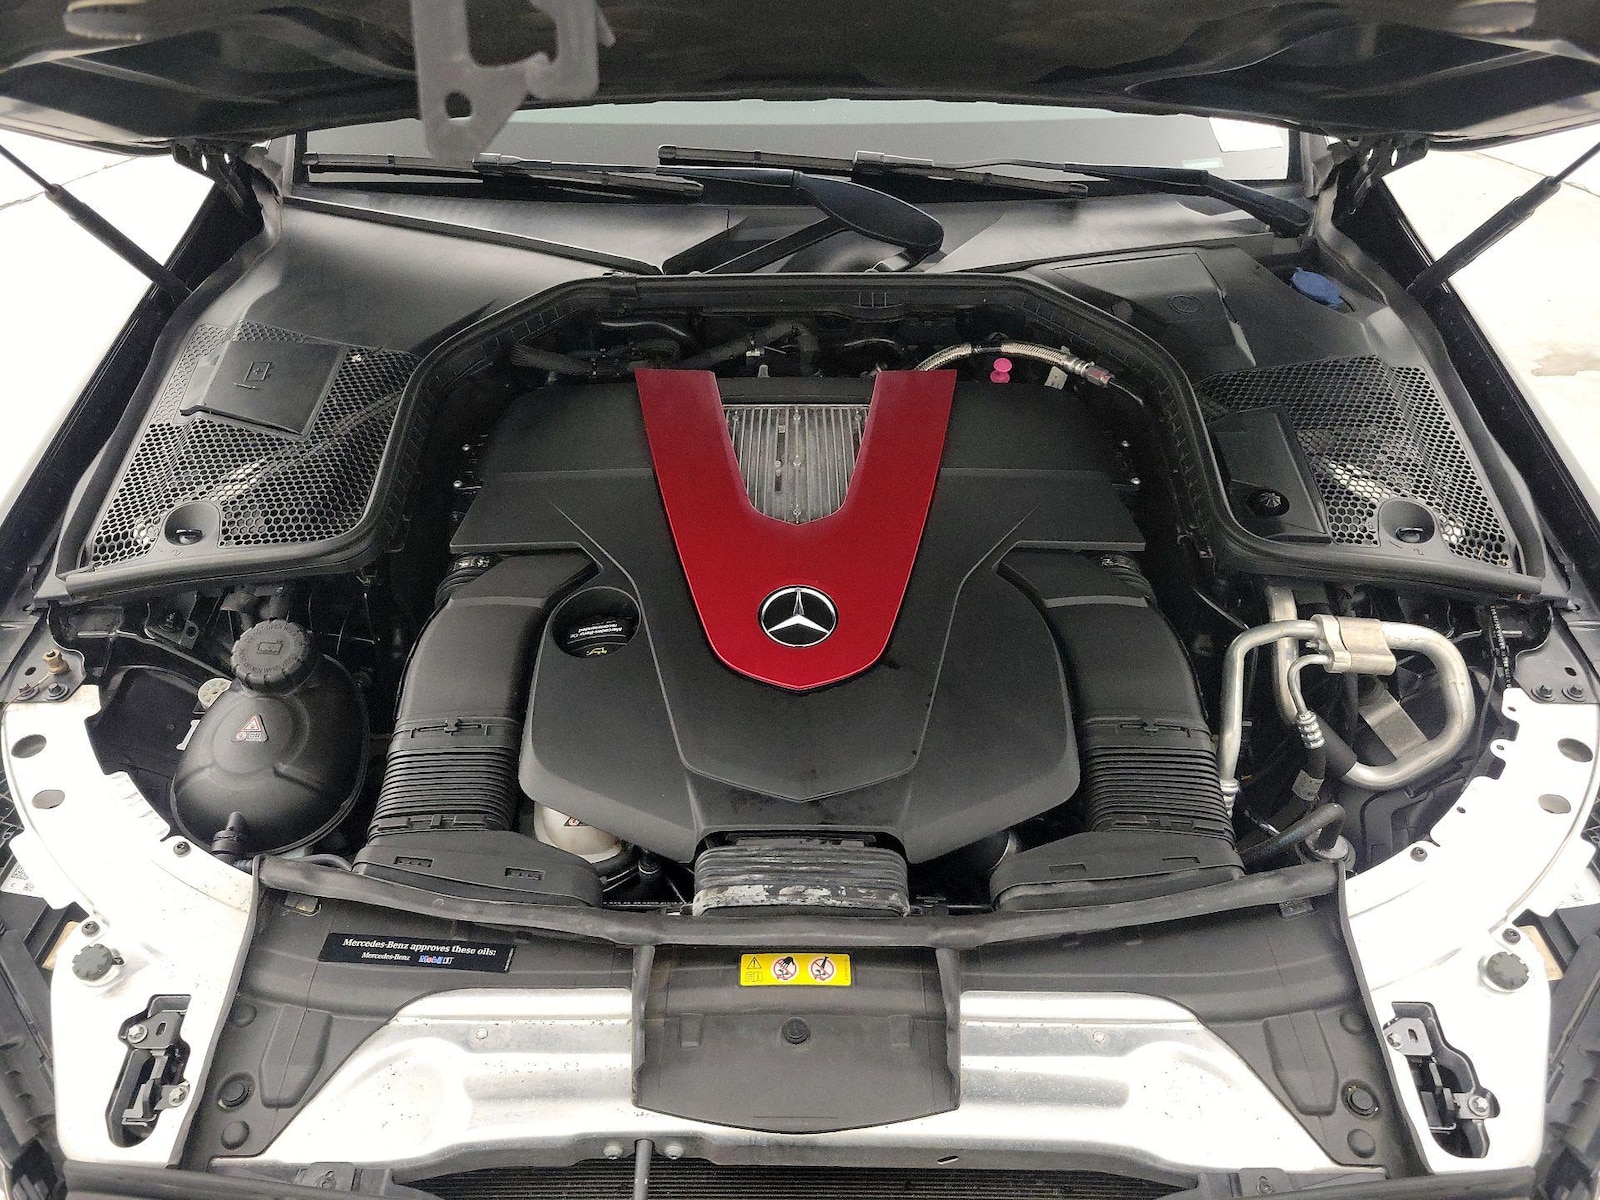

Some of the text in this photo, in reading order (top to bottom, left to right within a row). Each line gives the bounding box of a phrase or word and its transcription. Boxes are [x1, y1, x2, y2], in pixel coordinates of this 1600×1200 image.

[342, 938, 497, 957] Mercedes-Benz approves these oils:
[361, 951, 411, 961] Mercedes-Benz
